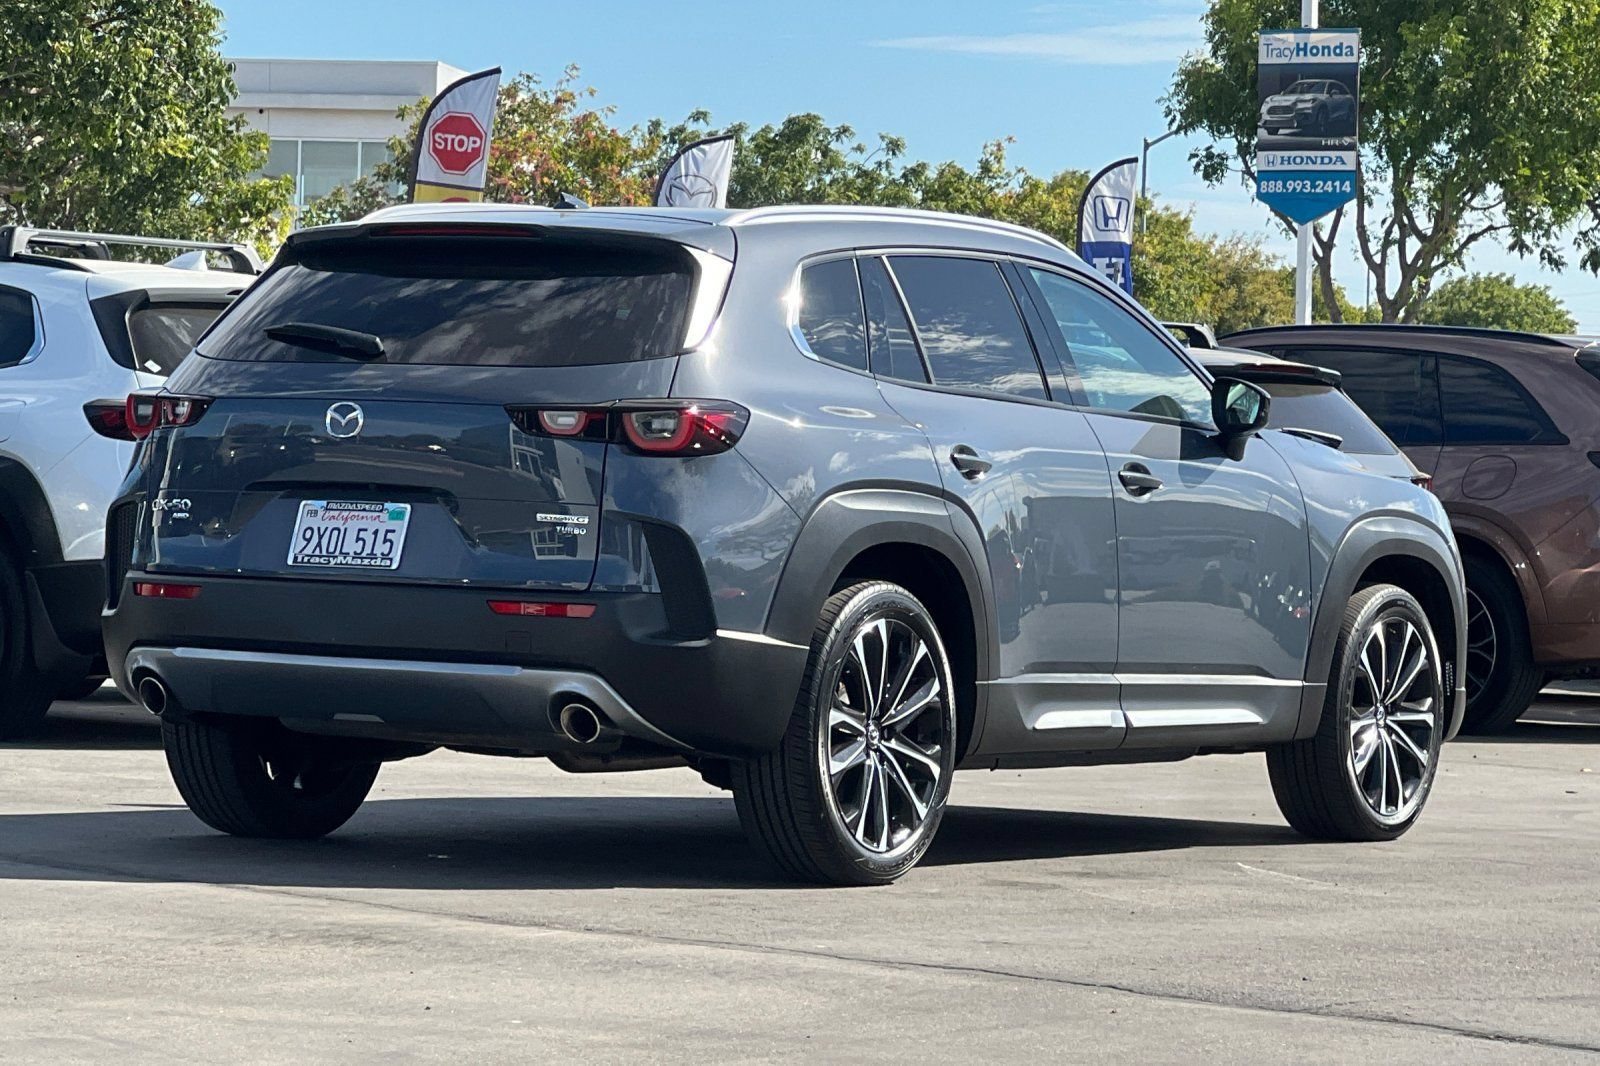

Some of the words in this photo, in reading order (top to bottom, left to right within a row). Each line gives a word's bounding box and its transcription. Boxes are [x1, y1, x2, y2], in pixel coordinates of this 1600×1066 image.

[434, 132, 480, 152] STOP
[1321, 138, 1350, 146] HR-V
[1280, 155, 1347, 165] HONDA
[1260, 180, 1351, 193] 888.993.2414
[152, 499, 191, 510] CX-50
[327, 502, 383, 511] MAZDASPEED
[306, 509, 318, 518] FEB
[321, 509, 386, 526] California
[556, 526, 586, 534] TURBO
[296, 554, 391, 566] TracyMazda
